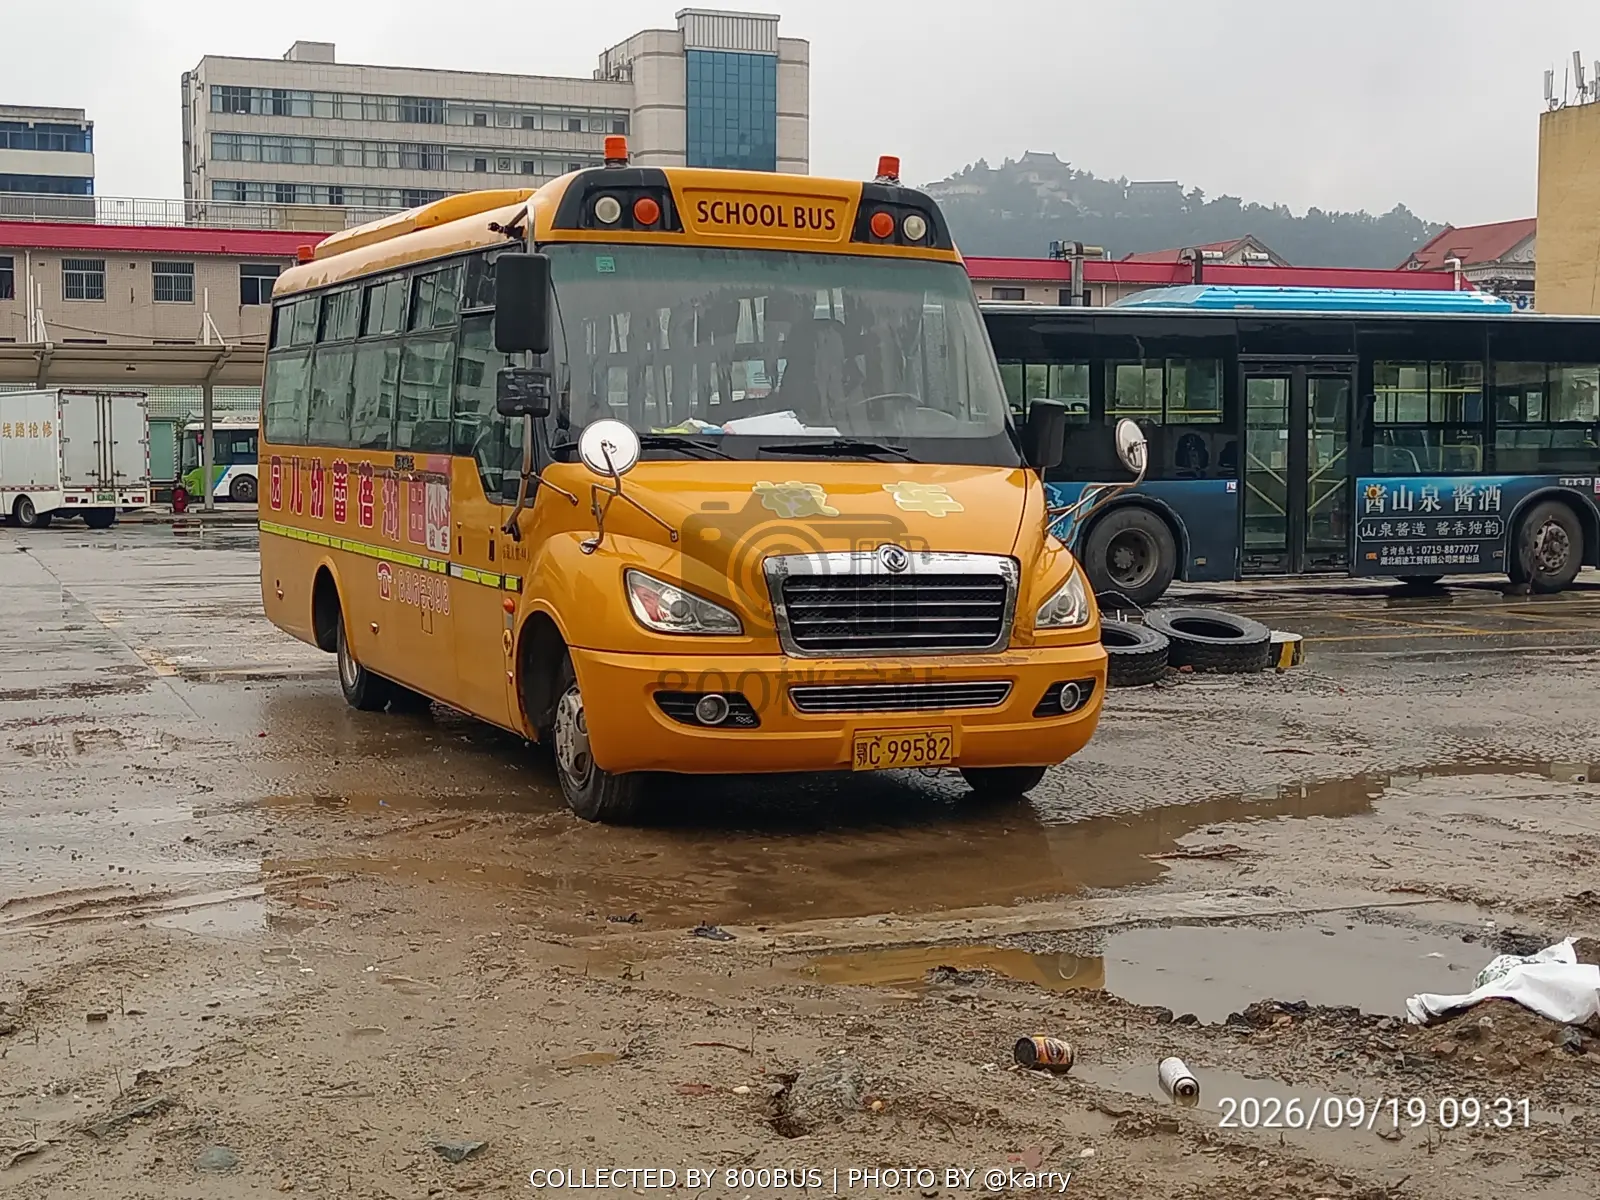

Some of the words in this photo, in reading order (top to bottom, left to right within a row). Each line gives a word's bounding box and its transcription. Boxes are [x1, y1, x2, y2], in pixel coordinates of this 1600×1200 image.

[696, 200, 788, 228] SCHOOL
[794, 205, 836, 231] BUS
[2, 420, 53, 439] 线路抢修
[1451, 483, 1502, 512] 酱酒
[1435, 519, 1499, 536] 酱香独韵
